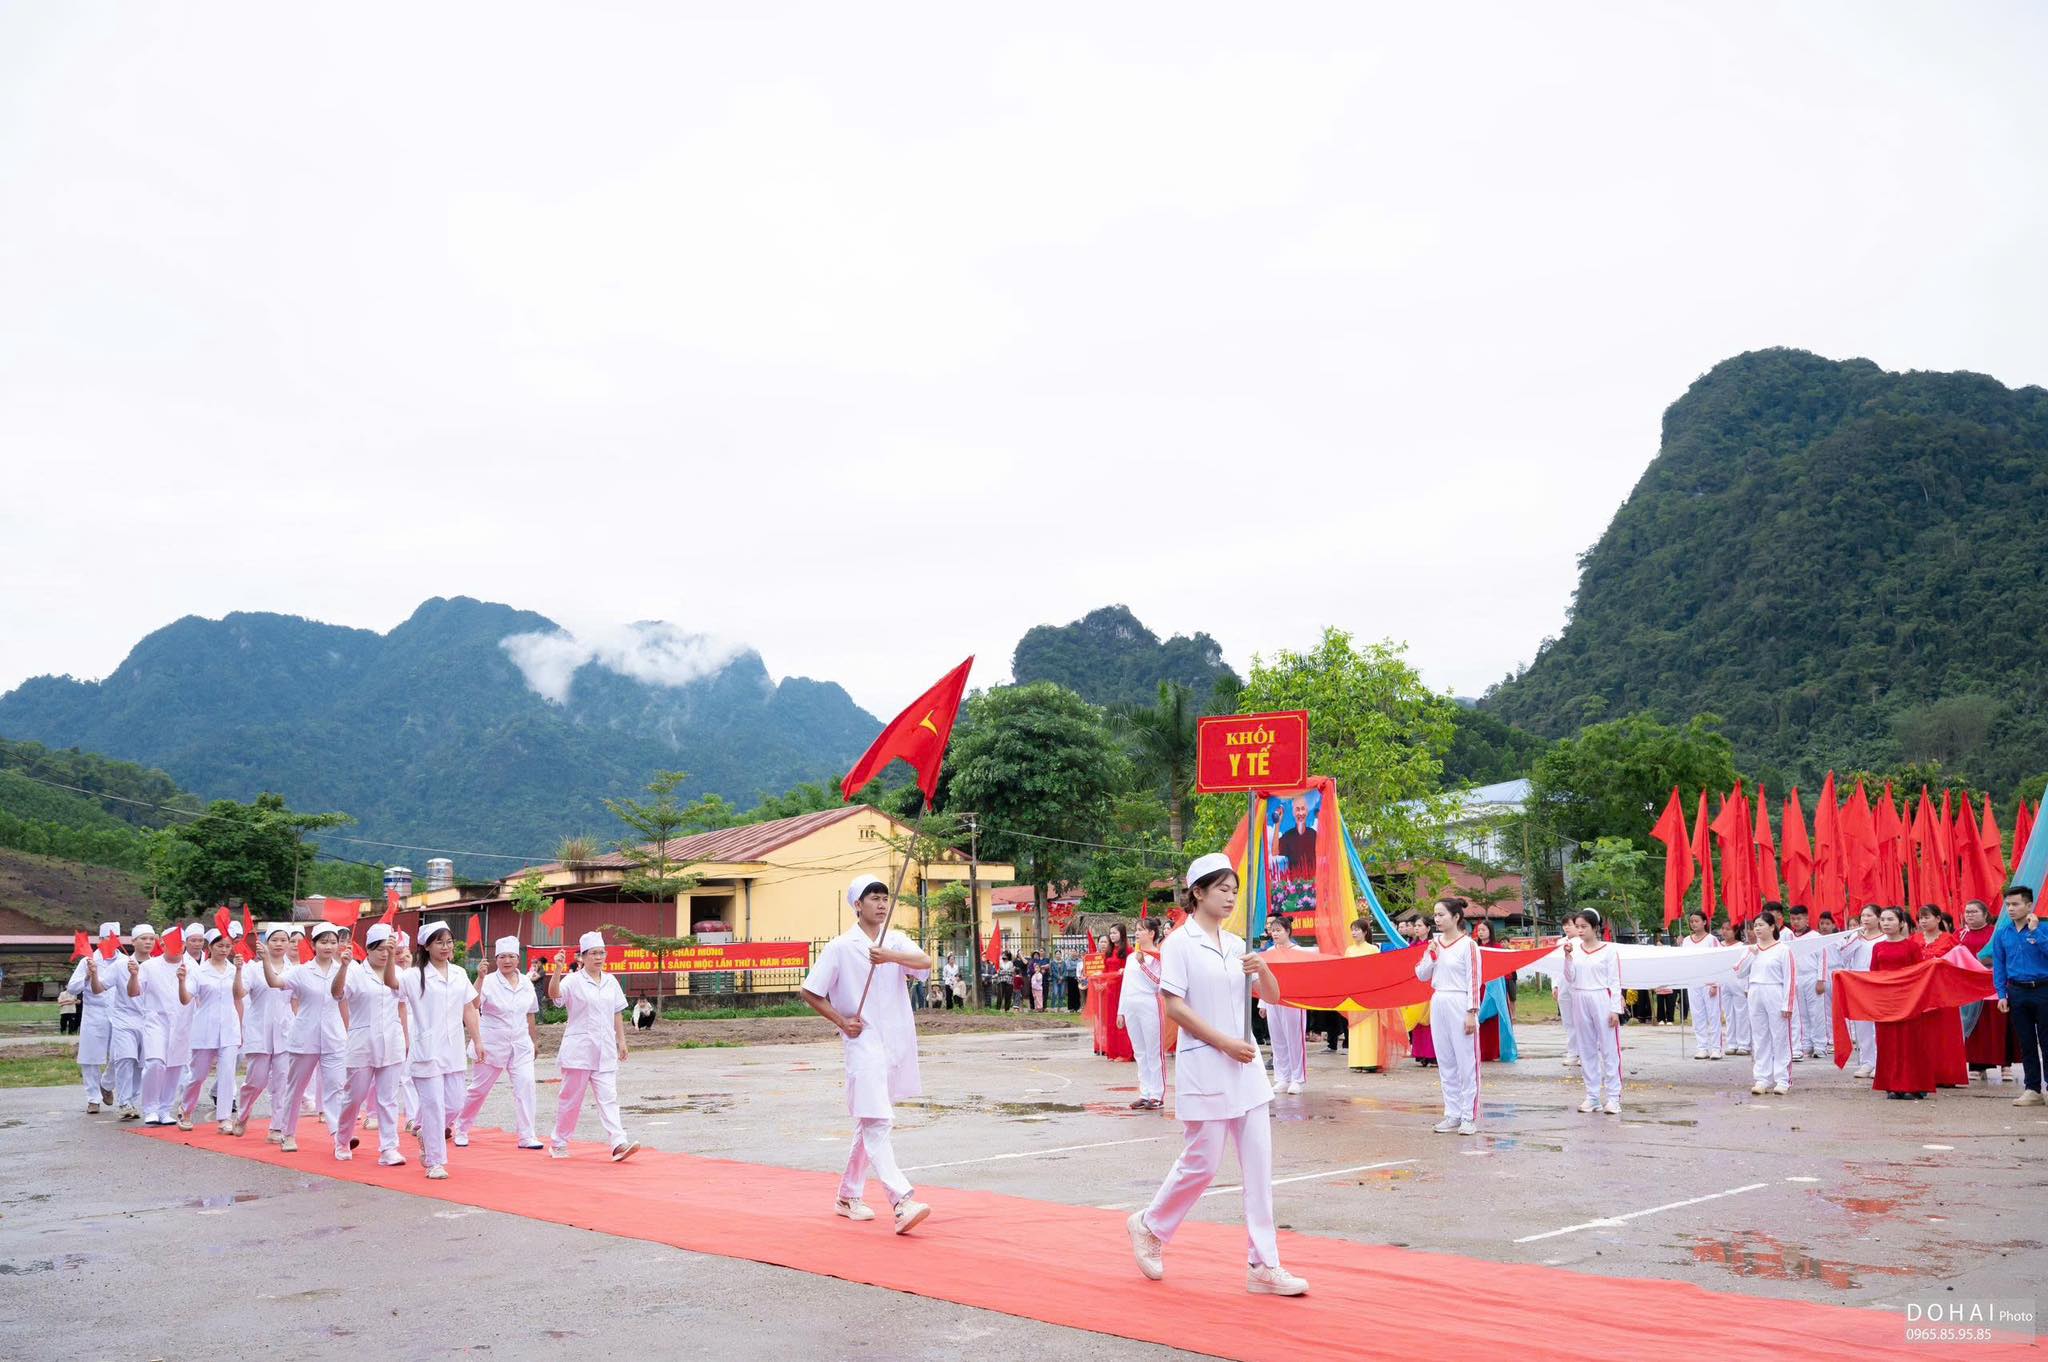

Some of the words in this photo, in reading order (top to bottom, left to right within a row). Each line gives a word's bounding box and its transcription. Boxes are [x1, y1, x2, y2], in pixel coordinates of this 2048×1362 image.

[1225, 724, 1275, 746] KHỐI
[1229, 753, 1242, 777] Y
[1247, 745, 1271, 776] TẾ
[628, 961, 651, 970] THAO
